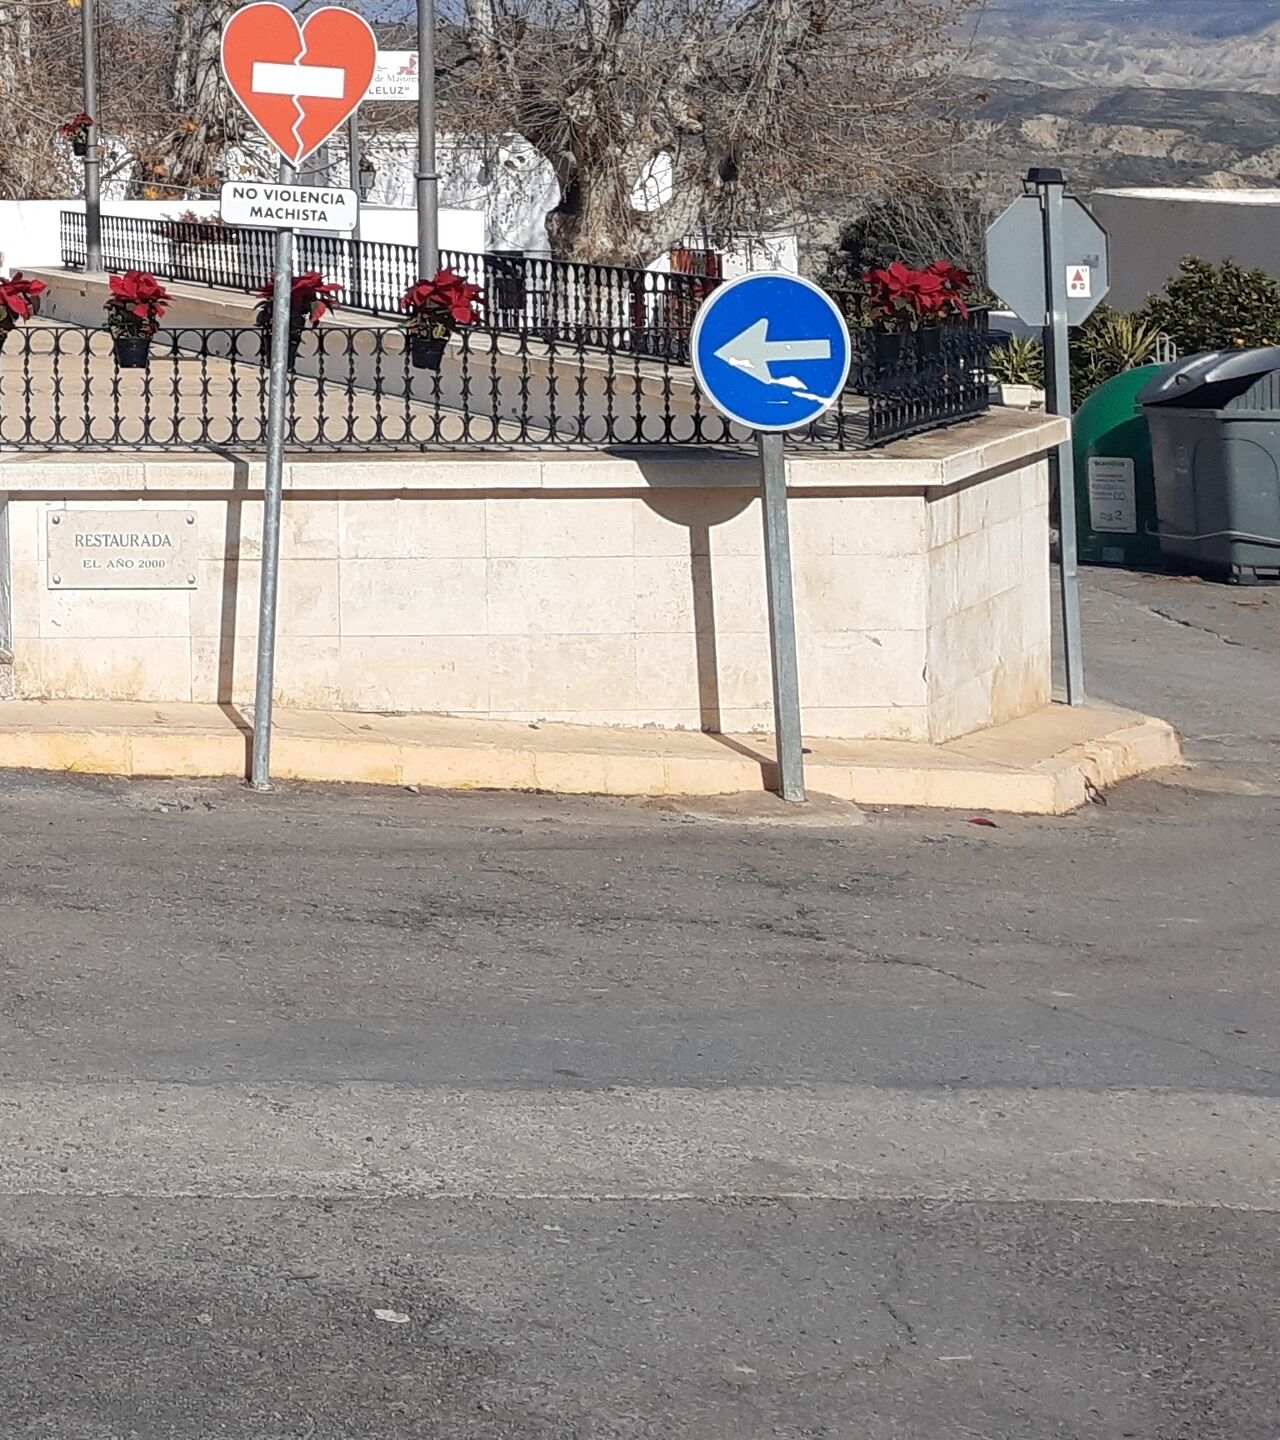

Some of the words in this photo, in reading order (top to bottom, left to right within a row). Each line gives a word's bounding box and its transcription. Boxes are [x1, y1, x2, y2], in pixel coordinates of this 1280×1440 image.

[233, 187, 258, 200] NO
[263, 188, 345, 206] VIOLENCIA
[250, 205, 328, 222] MACHISTA
[74, 533, 172, 548] RESTAURADA
[83, 559, 101, 569] EL
[106, 558, 134, 569] AÑO
[138, 559, 165, 569] 2000
